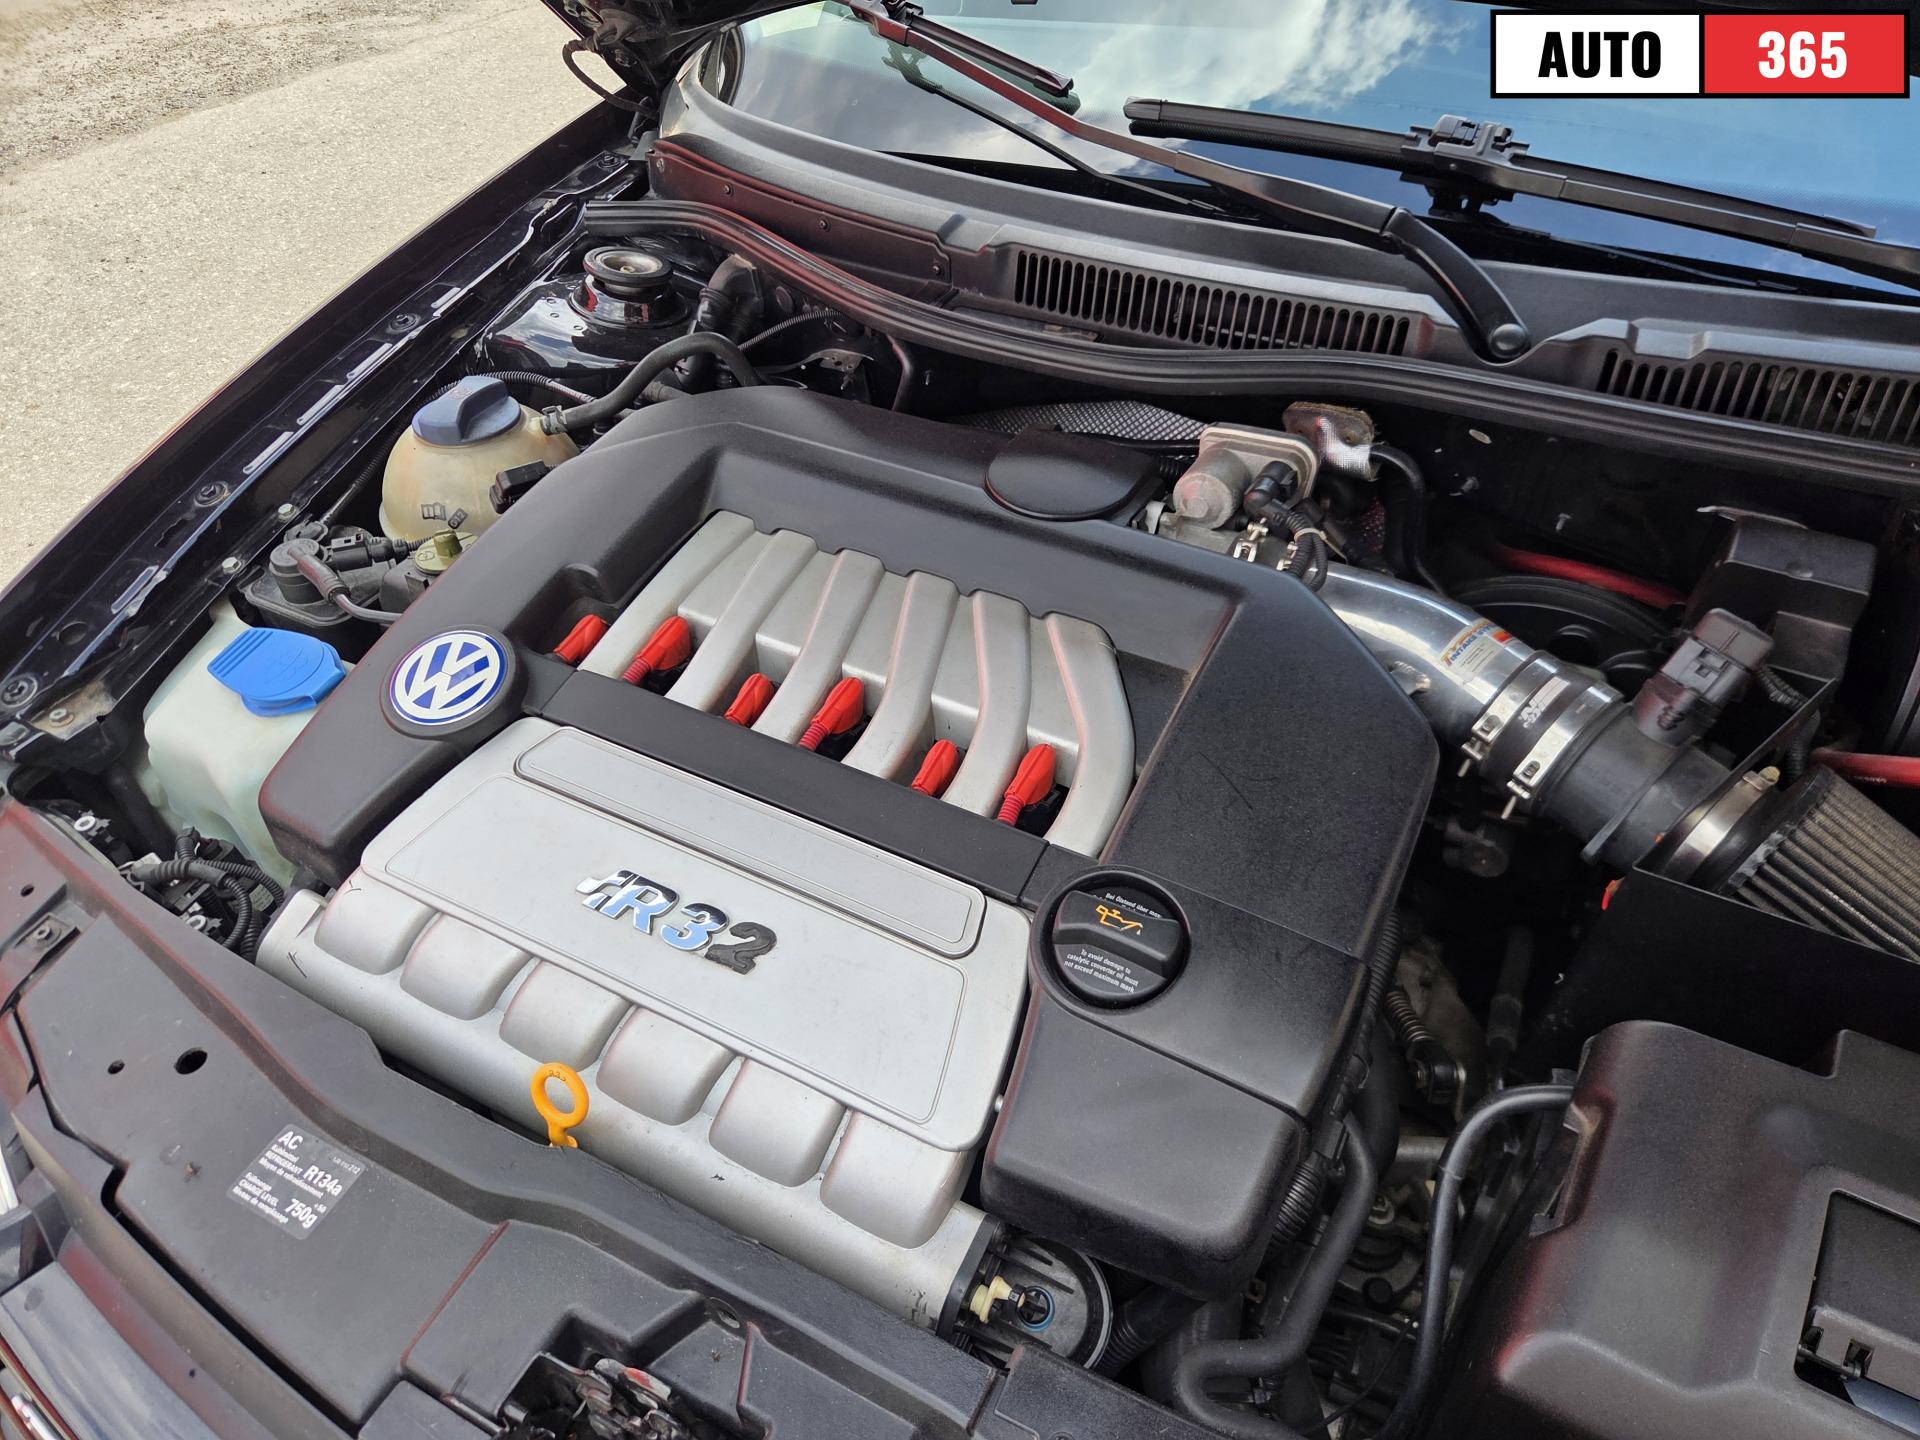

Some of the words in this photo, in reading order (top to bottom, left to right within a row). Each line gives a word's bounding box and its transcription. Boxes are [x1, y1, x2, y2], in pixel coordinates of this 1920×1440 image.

[576, 869, 778, 975] R32
[1067, 954, 1090, 965] catalytic
[1090, 962, 1116, 975] converter
[1116, 970, 1124, 979] oil
[1124, 976, 1138, 986] must
[1074, 962, 1094, 974] exceed
[1093, 971, 1120, 986] maximum
[1088, 953, 1103, 962] avoid
[1103, 958, 1124, 971] damage
[278, 1131, 303, 1150] AC
[303, 1165, 342, 1196] R134a
[260, 1190, 279, 1207] LEVEL
[278, 1198, 318, 1229] 750g
